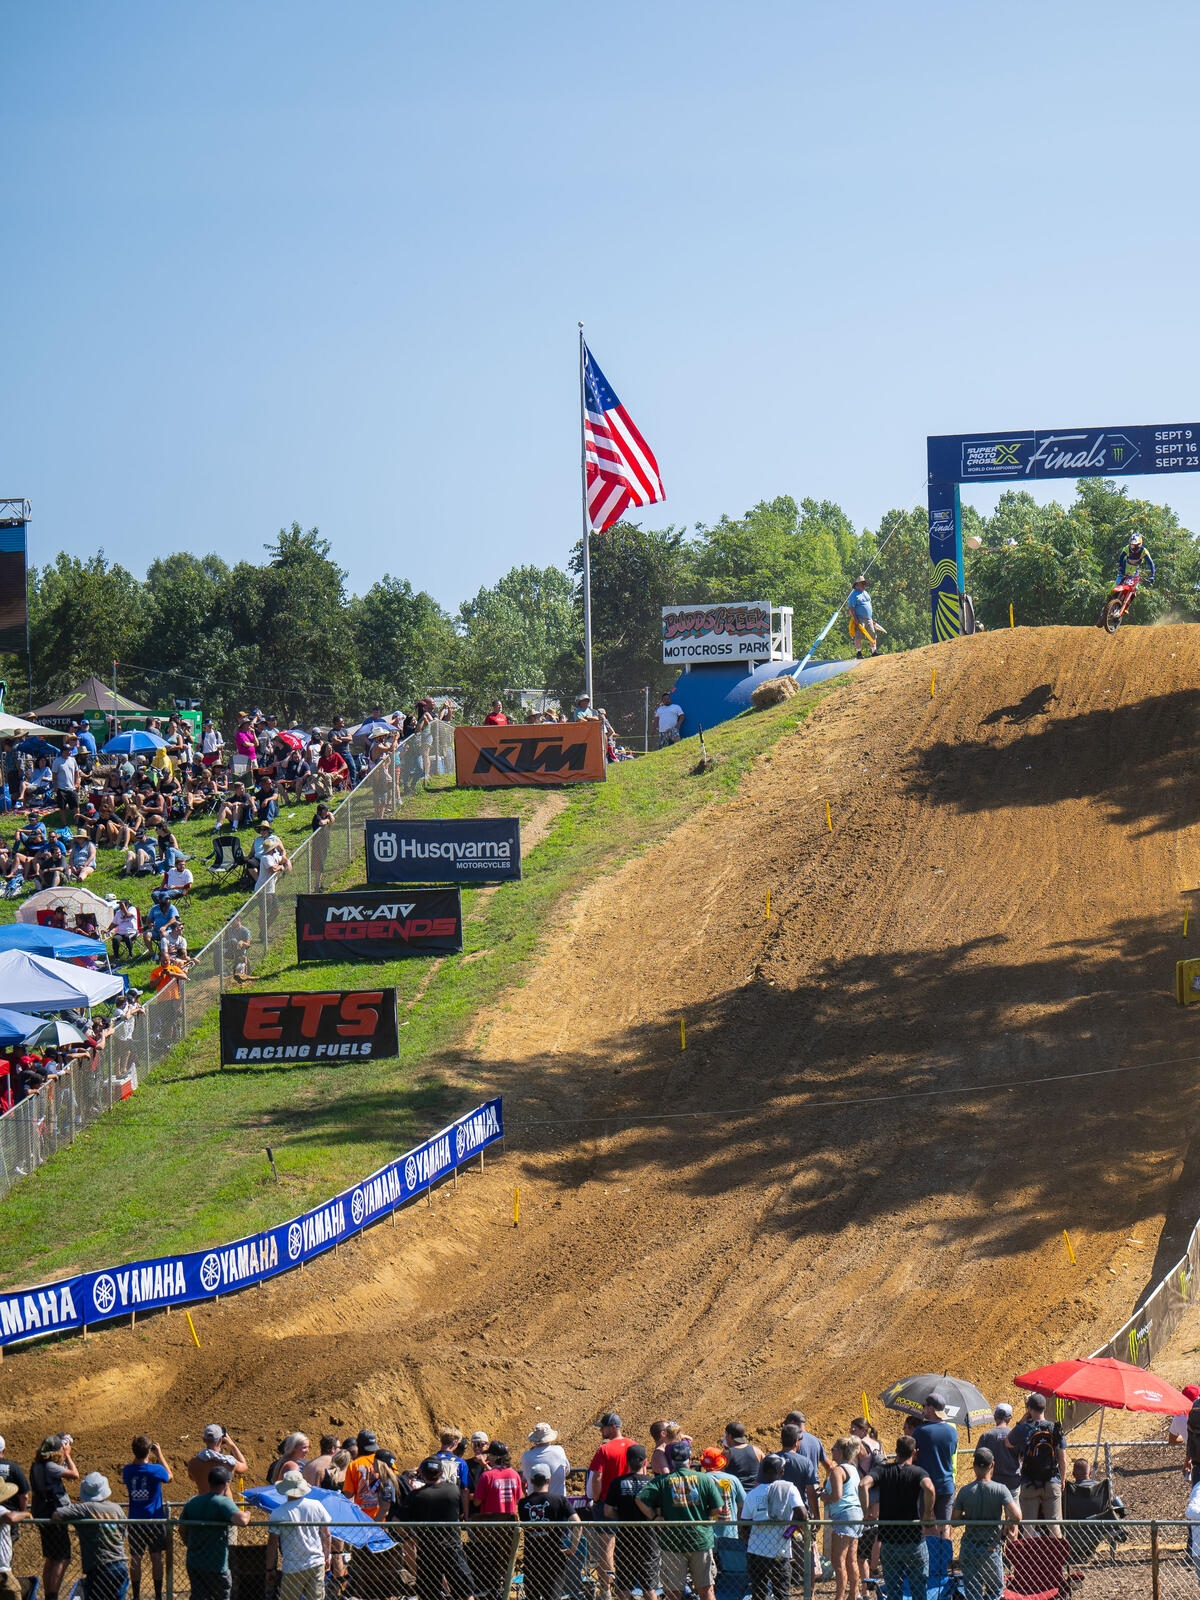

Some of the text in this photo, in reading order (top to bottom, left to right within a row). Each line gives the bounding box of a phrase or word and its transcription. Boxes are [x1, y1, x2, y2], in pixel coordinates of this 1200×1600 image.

[1155, 430, 1193, 441] SEPT 9
[967, 446, 998, 454] SUPER
[968, 452, 996, 460] MOTO
[1025, 434, 1107, 474] Finals
[1155, 443, 1197, 454] SEPT 16
[967, 458, 996, 466] CROSS
[1156, 456, 1199, 467] SEPT 23
[664, 641, 769, 658] MOTOCROSS PARK
[473, 737, 588, 774] KTM
[401, 838, 510, 862] Husqvarna
[456, 861, 511, 869] MOTORCYCLES
[326, 905, 366, 922] MX
[370, 903, 417, 920] ATV
[302, 917, 457, 943] LEGENDS
[243, 991, 384, 1040] ETS
[315, 1042, 373, 1057] FUELS
[416, 1135, 451, 1184] YAMAHA
[363, 1166, 401, 1217] YAMAHA
[302, 1200, 346, 1252] YAMAHA
[220, 1234, 279, 1285] YAMAHA
[116, 1260, 187, 1306] YAMAHA
[0, 1286, 78, 1337] MAHA
